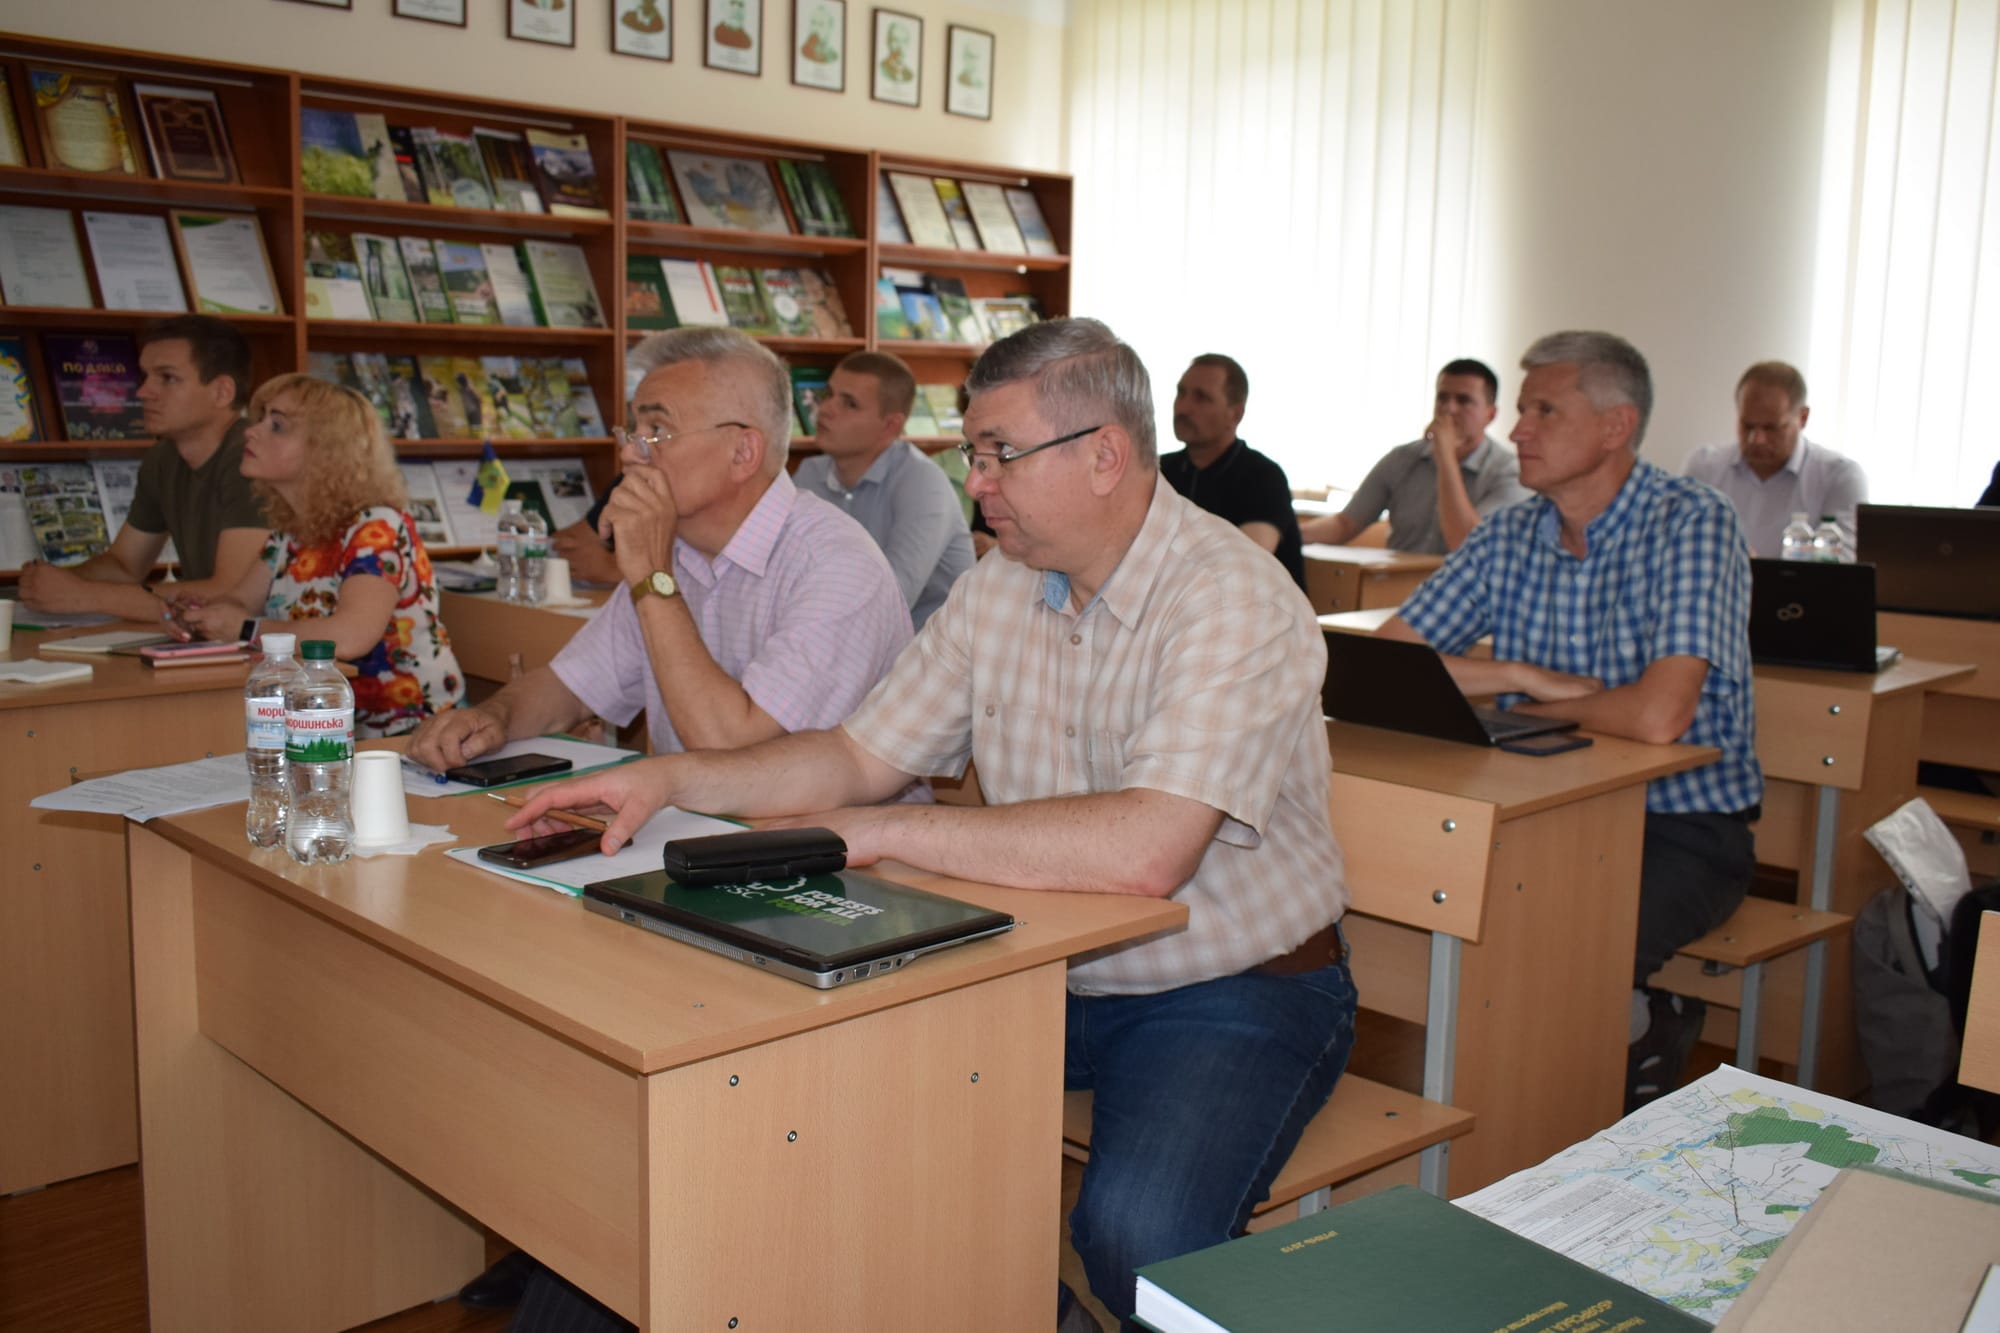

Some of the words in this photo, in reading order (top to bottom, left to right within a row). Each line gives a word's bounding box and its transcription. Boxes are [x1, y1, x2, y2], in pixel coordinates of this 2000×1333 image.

[783, 894, 827, 908] FOR
[823, 907, 864, 919] ALL
[802, 890, 884, 915] FORESTS
